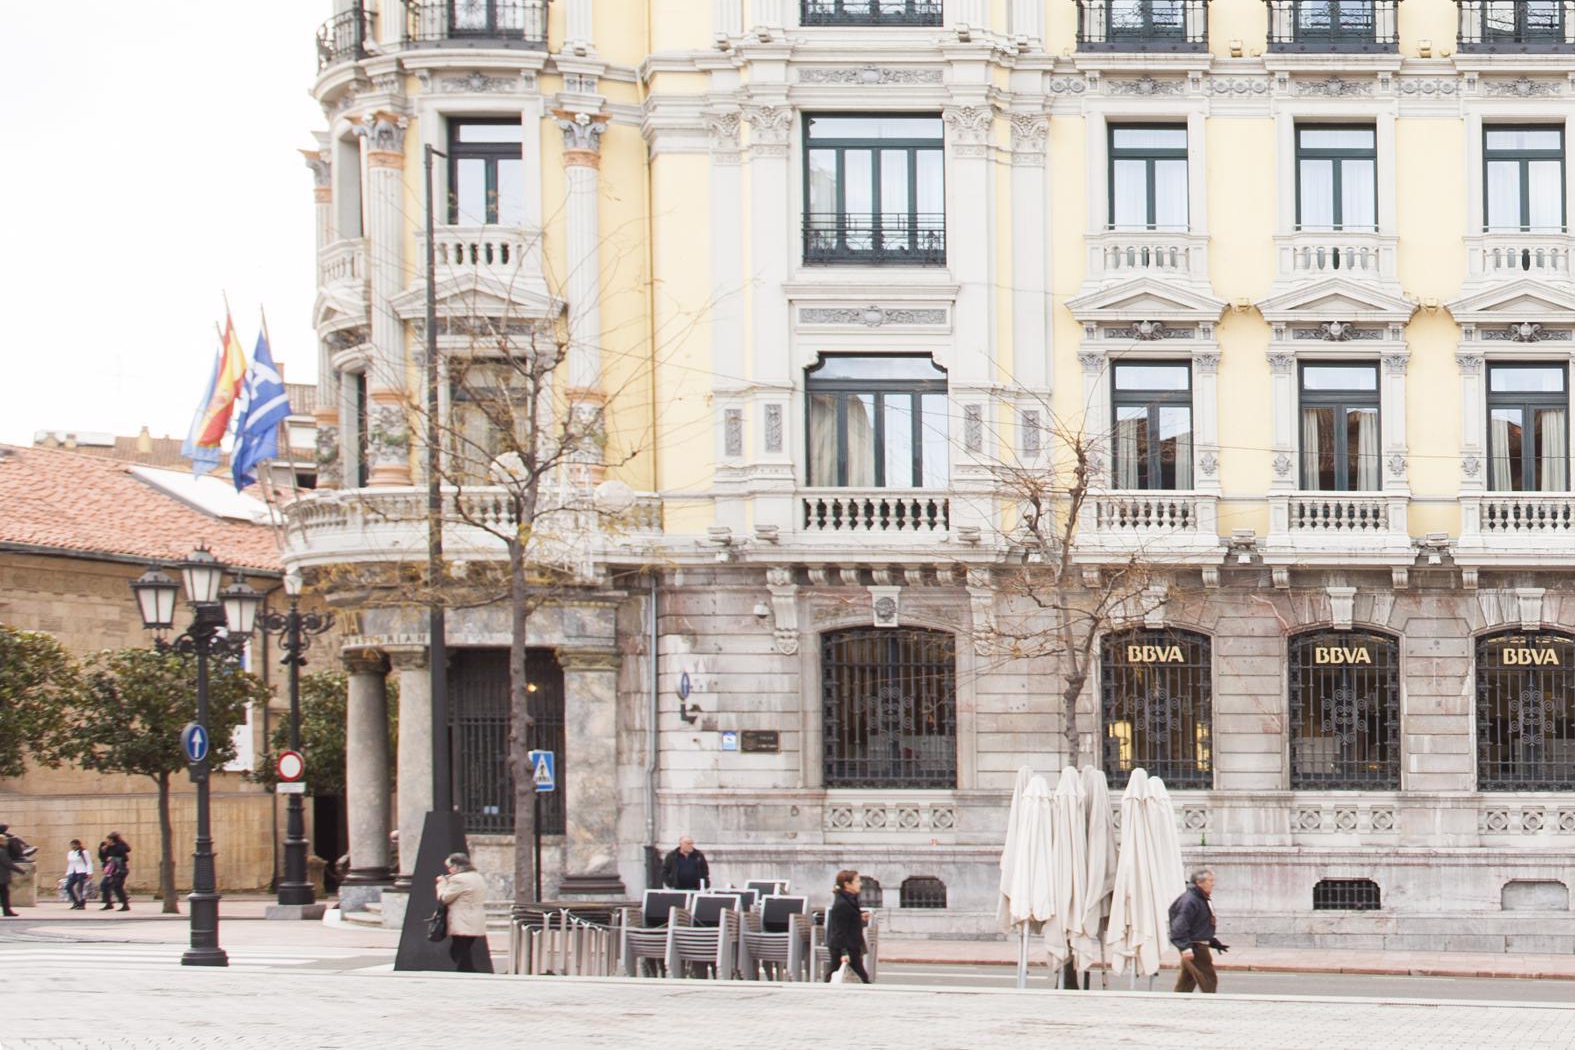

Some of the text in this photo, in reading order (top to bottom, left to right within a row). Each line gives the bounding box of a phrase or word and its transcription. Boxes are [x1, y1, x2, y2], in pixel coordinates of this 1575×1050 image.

[1128, 645, 1184, 662] BBVA
[1315, 647, 1371, 664] BBVA
[1503, 648, 1559, 665] BBVA
